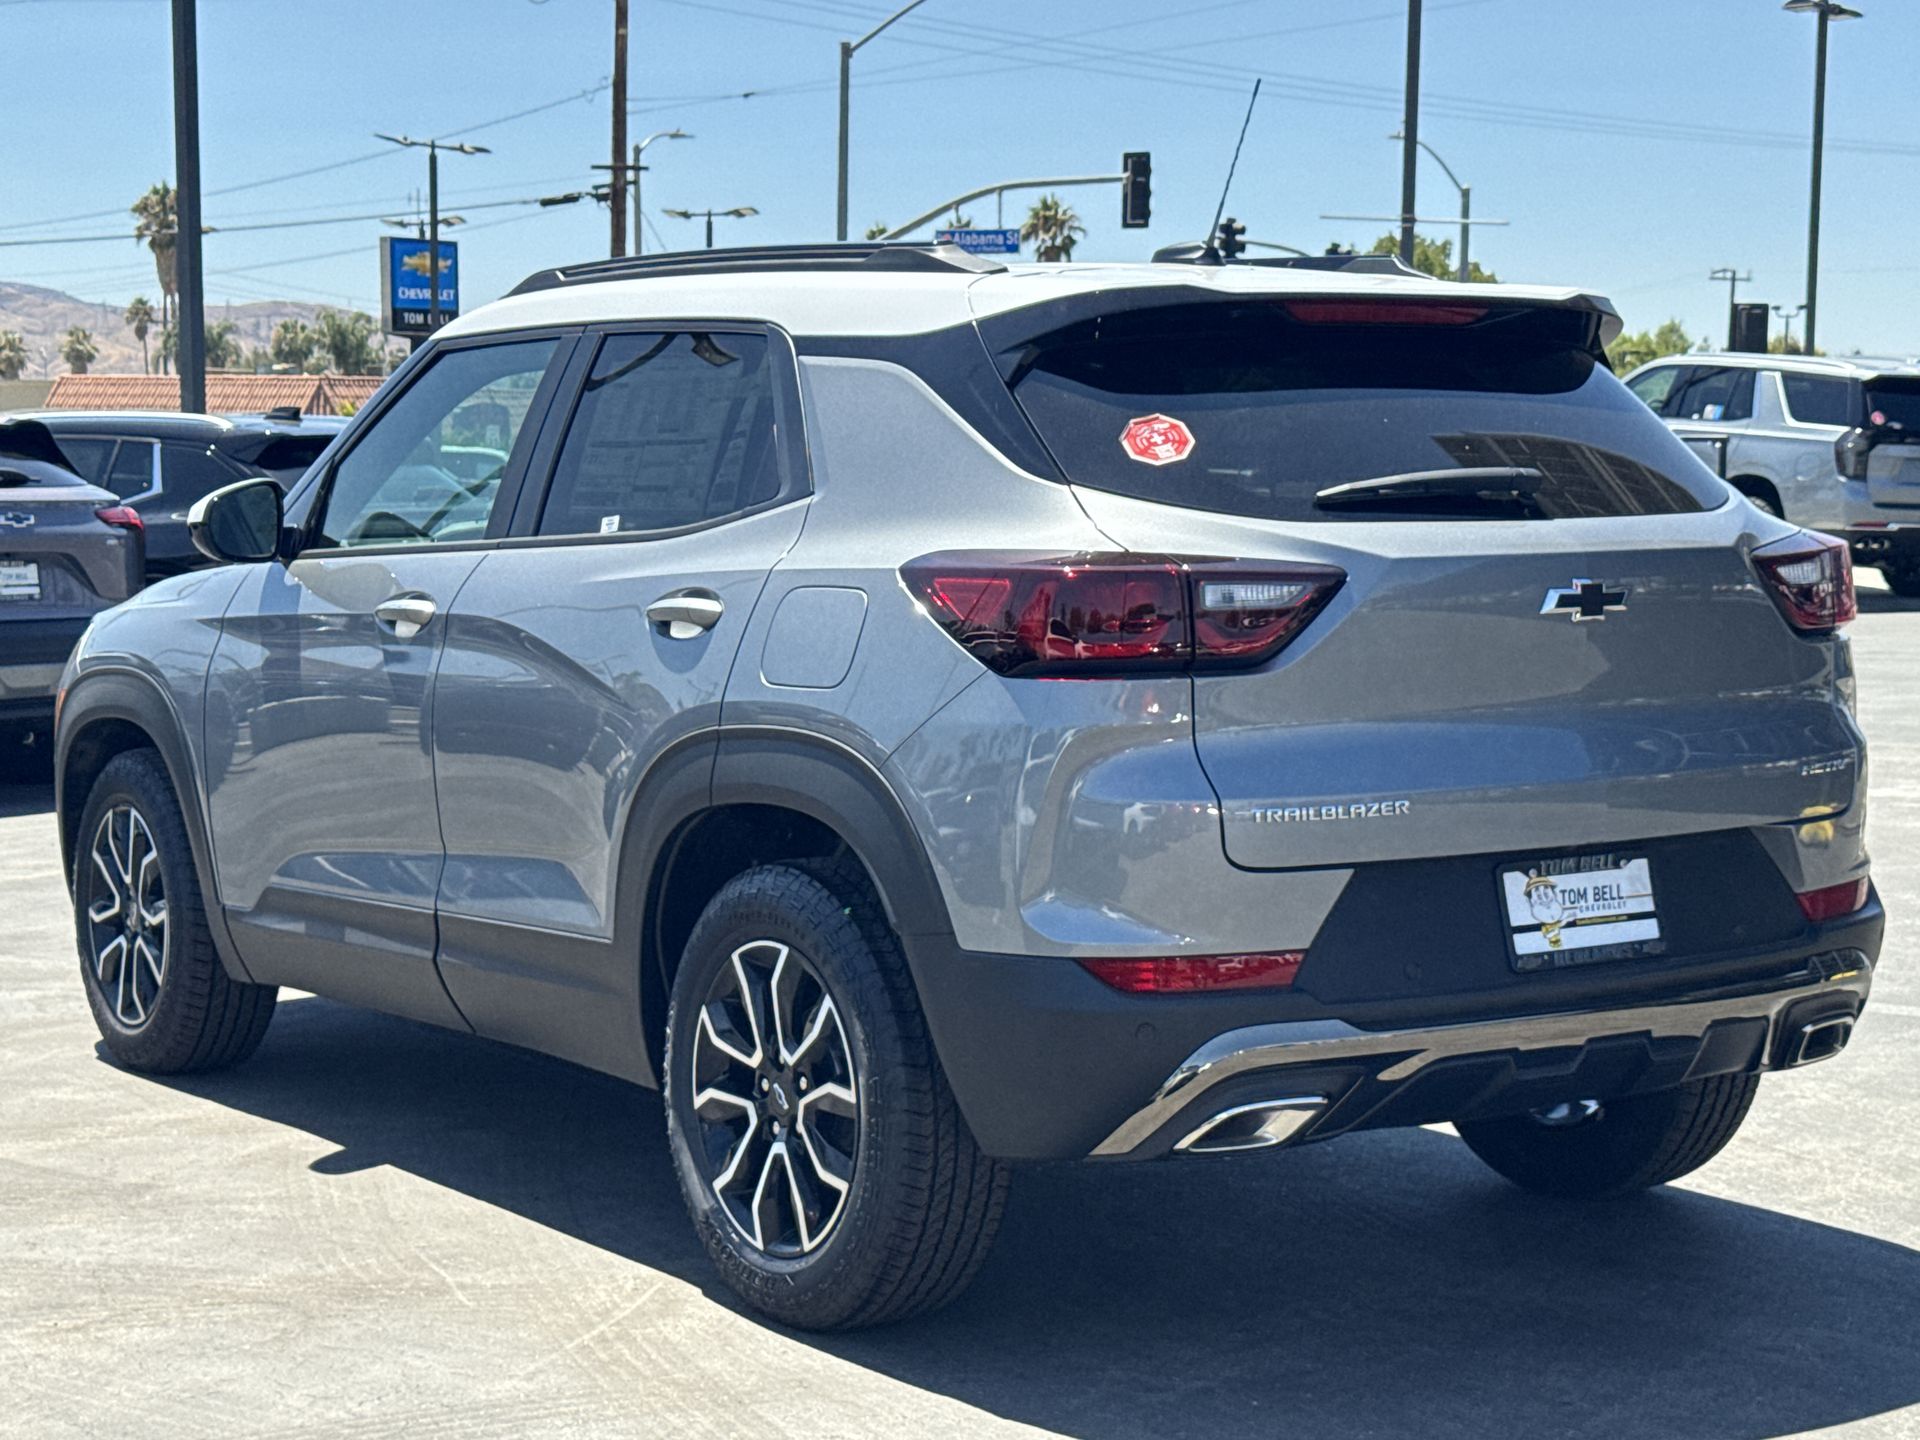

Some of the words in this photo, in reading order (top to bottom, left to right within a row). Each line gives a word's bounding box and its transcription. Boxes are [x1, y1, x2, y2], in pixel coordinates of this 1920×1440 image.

[953, 232, 1004, 245] Alabama
[1006, 231, 1018, 245] St
[398, 286, 456, 301] CHEVRLET
[403, 312, 425, 325] TOM
[427, 313, 449, 325] BLL
[1252, 800, 1411, 823] TRAILBLAZER
[1540, 857, 1577, 875] TOM
[1579, 853, 1617, 872] BELL
[1559, 887, 1588, 906] TOM
[1593, 884, 1625, 902] BELL
[1578, 900, 1627, 913] CHEVROLET
